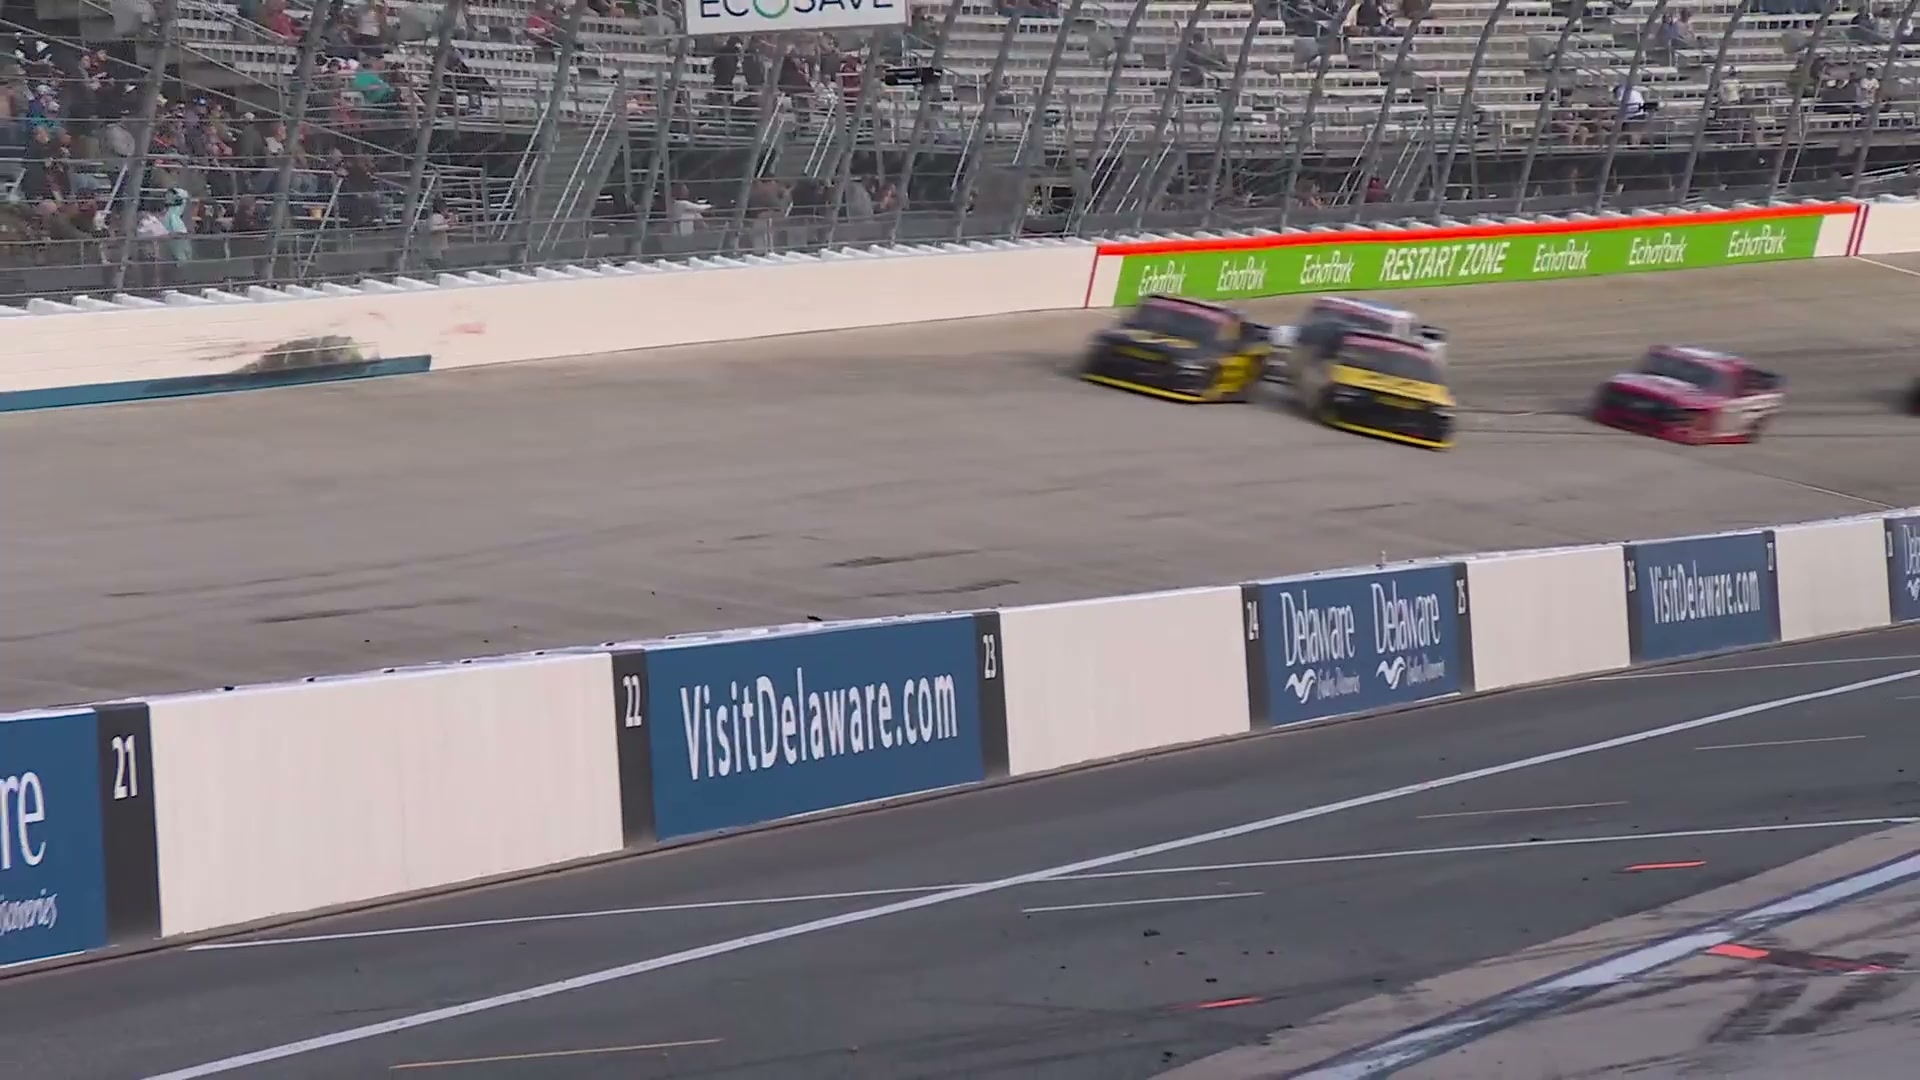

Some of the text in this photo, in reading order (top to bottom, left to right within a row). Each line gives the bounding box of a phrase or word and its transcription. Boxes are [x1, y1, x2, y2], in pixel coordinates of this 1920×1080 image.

[1379, 241, 1511, 282] RESTART ZONE
[1532, 239, 1592, 273] EchoPark
[1627, 232, 1688, 266] EchoPark
[1726, 224, 1787, 258] EchoPark
[1138, 260, 1187, 296] EchoPark
[1216, 256, 1268, 292] EchoPark
[1300, 250, 1355, 285] EchoPark
[1456, 578, 1467, 615] 25
[1648, 559, 1761, 625] VisitDelaware.com
[1246, 600, 1260, 641] 24
[1280, 588, 1356, 667] Delaware
[1371, 579, 1441, 655] Delaware
[982, 633, 997, 680] 23
[622, 673, 643, 728] 22
[679, 666, 959, 782] VisitDelaware.com
[110, 734, 139, 800] 21
